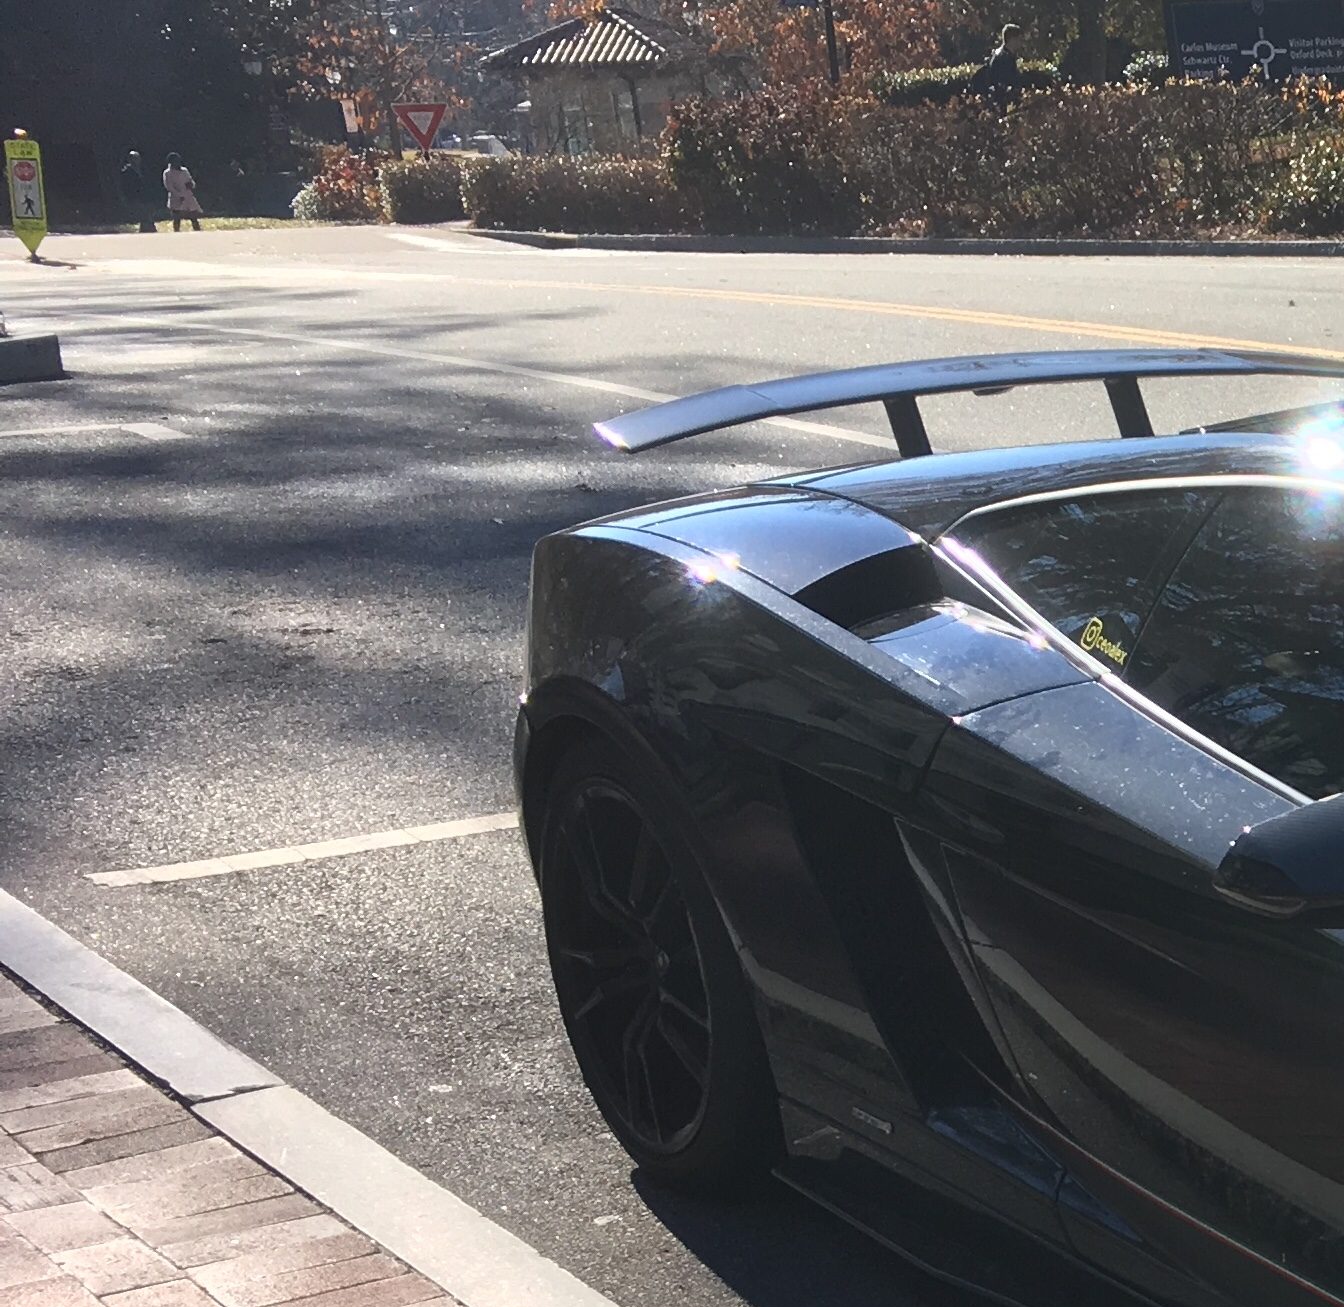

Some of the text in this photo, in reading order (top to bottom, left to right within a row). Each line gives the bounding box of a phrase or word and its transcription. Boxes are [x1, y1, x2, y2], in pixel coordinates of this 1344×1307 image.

[1181, 42, 1238, 52] Carlos Museum
[1315, 36, 1344, 48] Parking
[1290, 49, 1315, 60] Oxford
